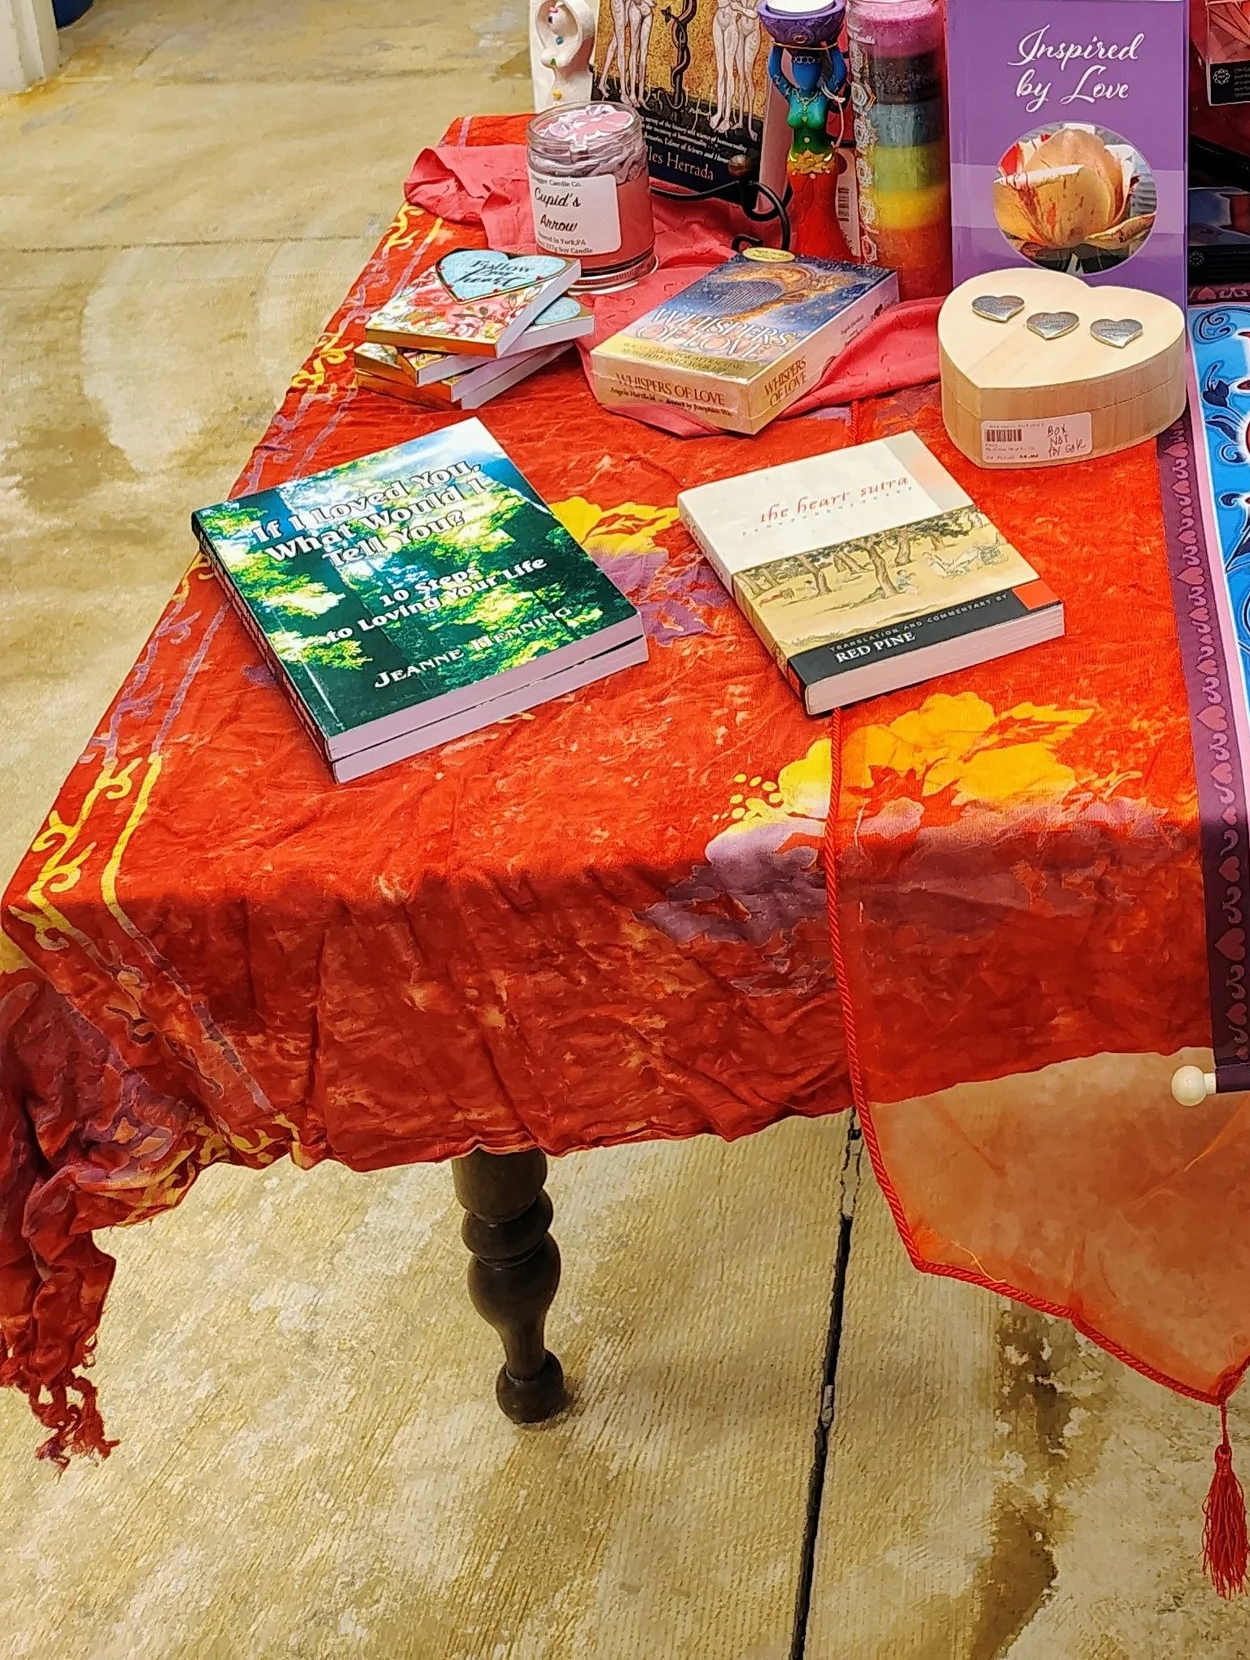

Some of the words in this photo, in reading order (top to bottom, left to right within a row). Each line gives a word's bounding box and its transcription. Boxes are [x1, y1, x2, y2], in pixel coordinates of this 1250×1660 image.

[1006, 23, 1145, 75] Inspired
[1015, 68, 1051, 113] by
[1066, 63, 1130, 108] Love
[666, 151, 714, 180] Herrada
[534, 188, 582, 207] Cupid's
[540, 215, 578, 232] Arrow
[651, 308, 797, 347] WHISPERS
[616, 373, 672, 396] WHISPERS
[674, 383, 692, 397] OF
[694, 387, 725, 406] LOVE
[763, 357, 807, 396] WHISPERS
[253, 520, 287, 542] If
[311, 480, 410, 526] Loved
[409, 460, 482, 491] You,
[760, 503, 789, 524] the
[797, 492, 851, 514] heart
[860, 476, 908, 497] sutra
[264, 522, 356, 564] What
[360, 489, 464, 531] Would
[322, 536, 387, 567] Tell
[389, 509, 466, 546] You?
[327, 627, 354, 644] to
[358, 596, 441, 632] Loving
[442, 576, 497, 602] Your
[502, 556, 548, 581] Life
[379, 589, 410, 608] 10
[415, 564, 482, 594] Steps
[829, 628, 899, 653] TRANSLATION
[903, 619, 923, 632] AND
[926, 599, 992, 624] COMMENTARY
[995, 593, 1008, 603] BY
[834, 644, 871, 664] RED
[874, 631, 916, 651] PINE
